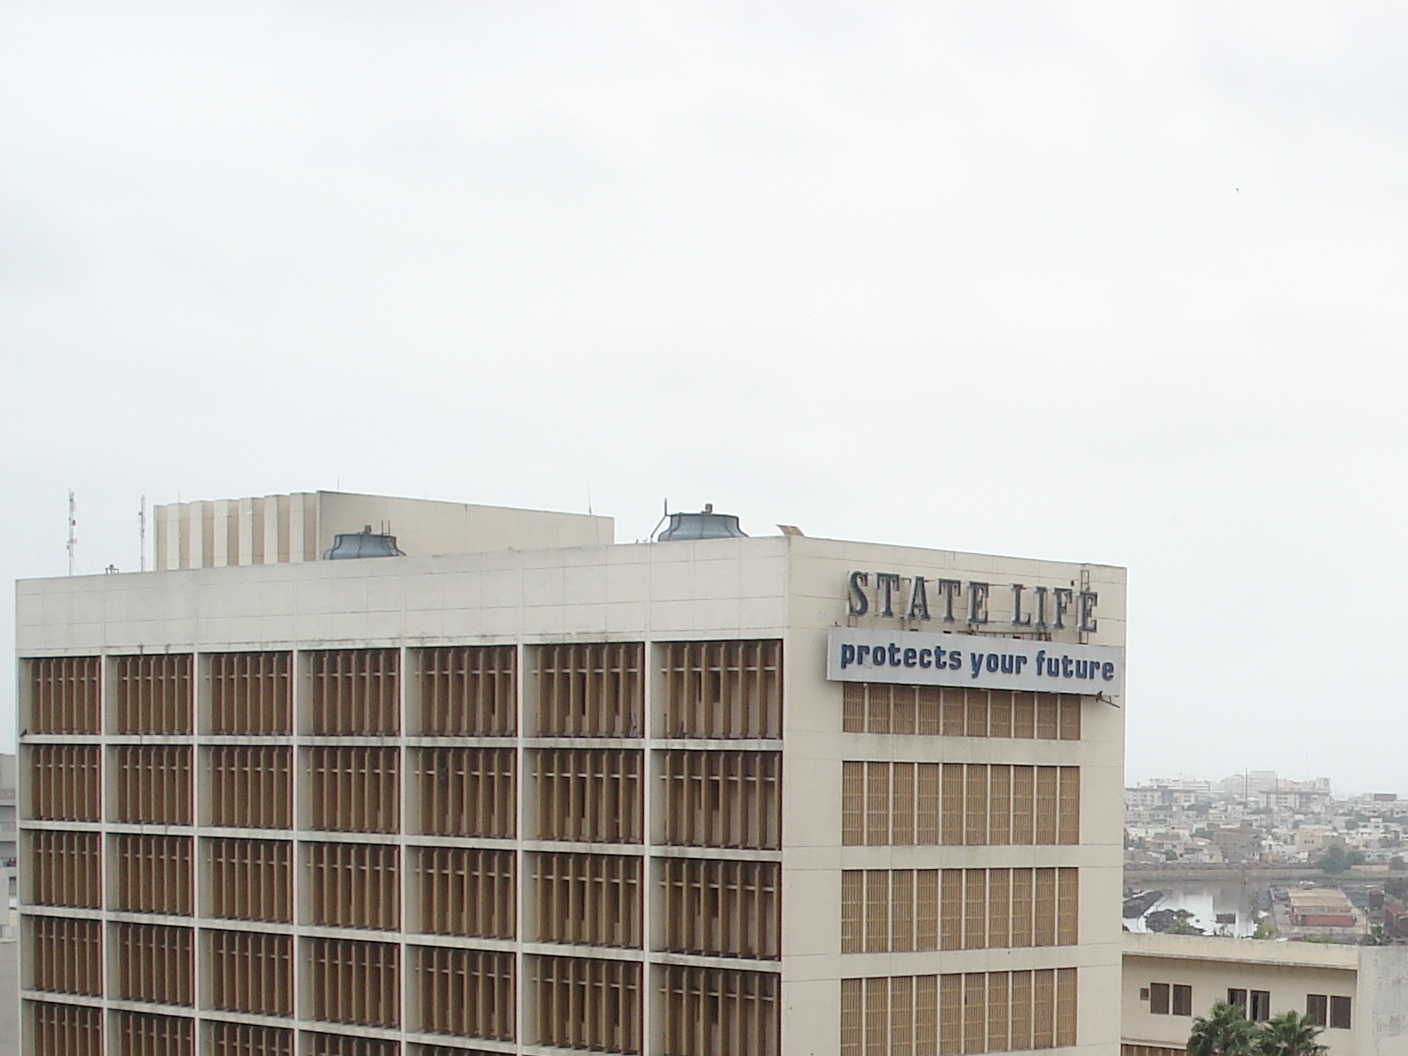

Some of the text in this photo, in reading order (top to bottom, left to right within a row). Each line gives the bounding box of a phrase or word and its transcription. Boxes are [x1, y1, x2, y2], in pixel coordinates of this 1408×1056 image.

[846, 571, 1098, 633] STATE LIFE
[841, 642, 1114, 681] protects your future
